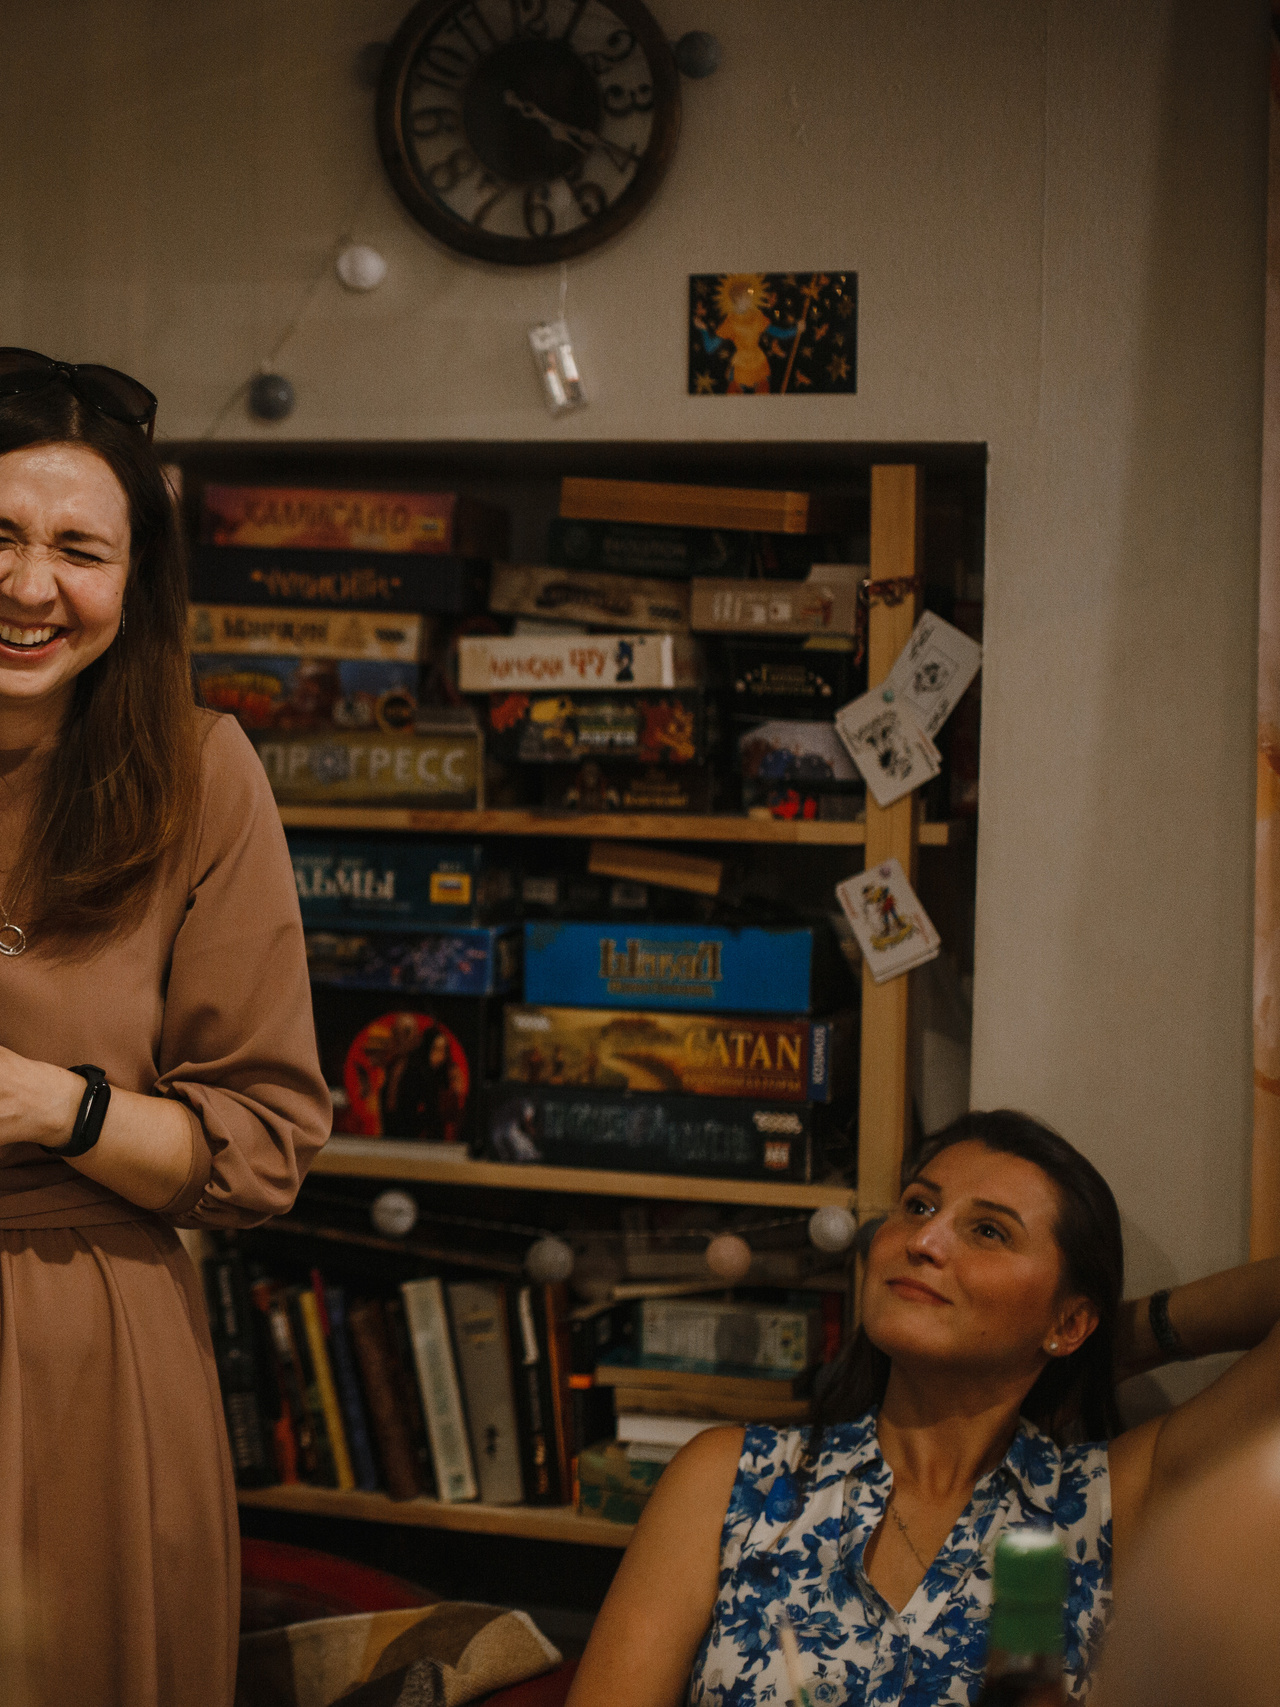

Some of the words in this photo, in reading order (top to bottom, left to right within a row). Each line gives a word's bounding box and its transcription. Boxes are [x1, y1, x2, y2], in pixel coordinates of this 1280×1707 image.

[415, 45, 466, 90] 10
[583, 28, 637, 74] 2
[411, 106, 459, 137] 9
[604, 83, 654, 117] 3
[427, 147, 477, 192] 8
[523, 184, 555, 238] 6
[565, 168, 608, 218] 5
[260, 742, 466, 783] ПРОГРЕСС
[685, 1029, 802, 1071] CATAN
